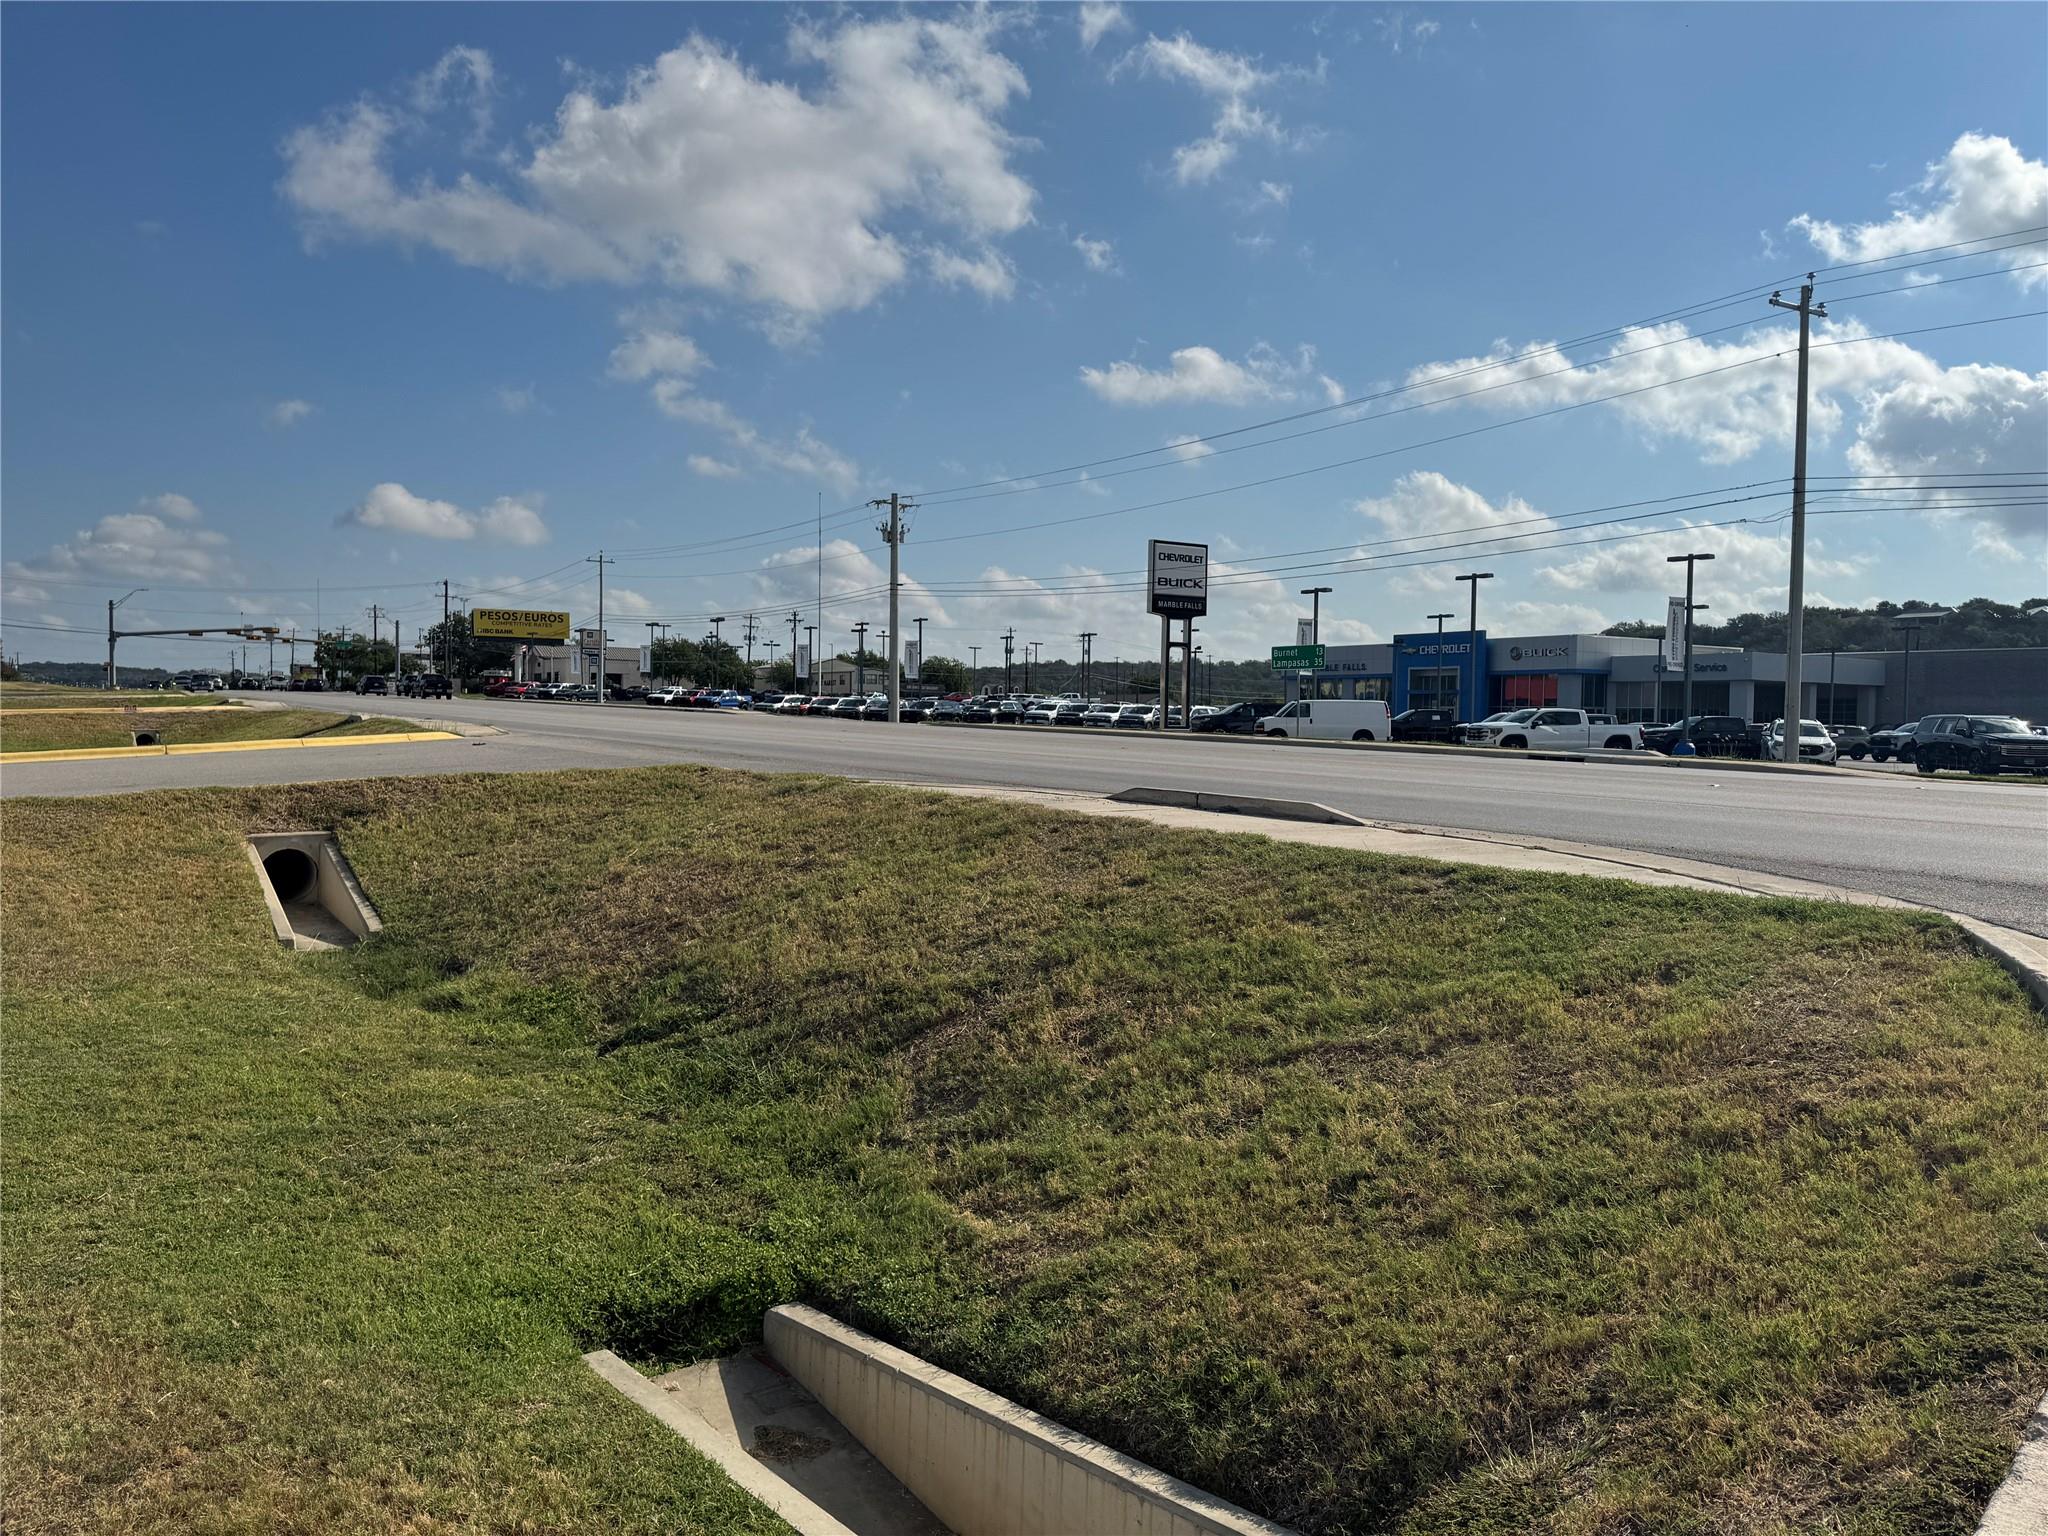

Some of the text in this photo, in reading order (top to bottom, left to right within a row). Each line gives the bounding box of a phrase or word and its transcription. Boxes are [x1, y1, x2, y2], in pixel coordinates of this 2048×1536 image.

[1158, 552, 1204, 564] CHEVROLET
[1158, 577, 1203, 589] BUICK
[1158, 600, 1203, 610] MARBLE FALLS
[480, 611, 564, 623] PESOS/EUROS
[1273, 649, 1298, 657] Burnet
[1522, 647, 1568, 657] BUICK
[1273, 658, 1323, 669] Lampasas 35
[1342, 663, 1367, 671] FALLS
[1693, 663, 1728, 673] Service
